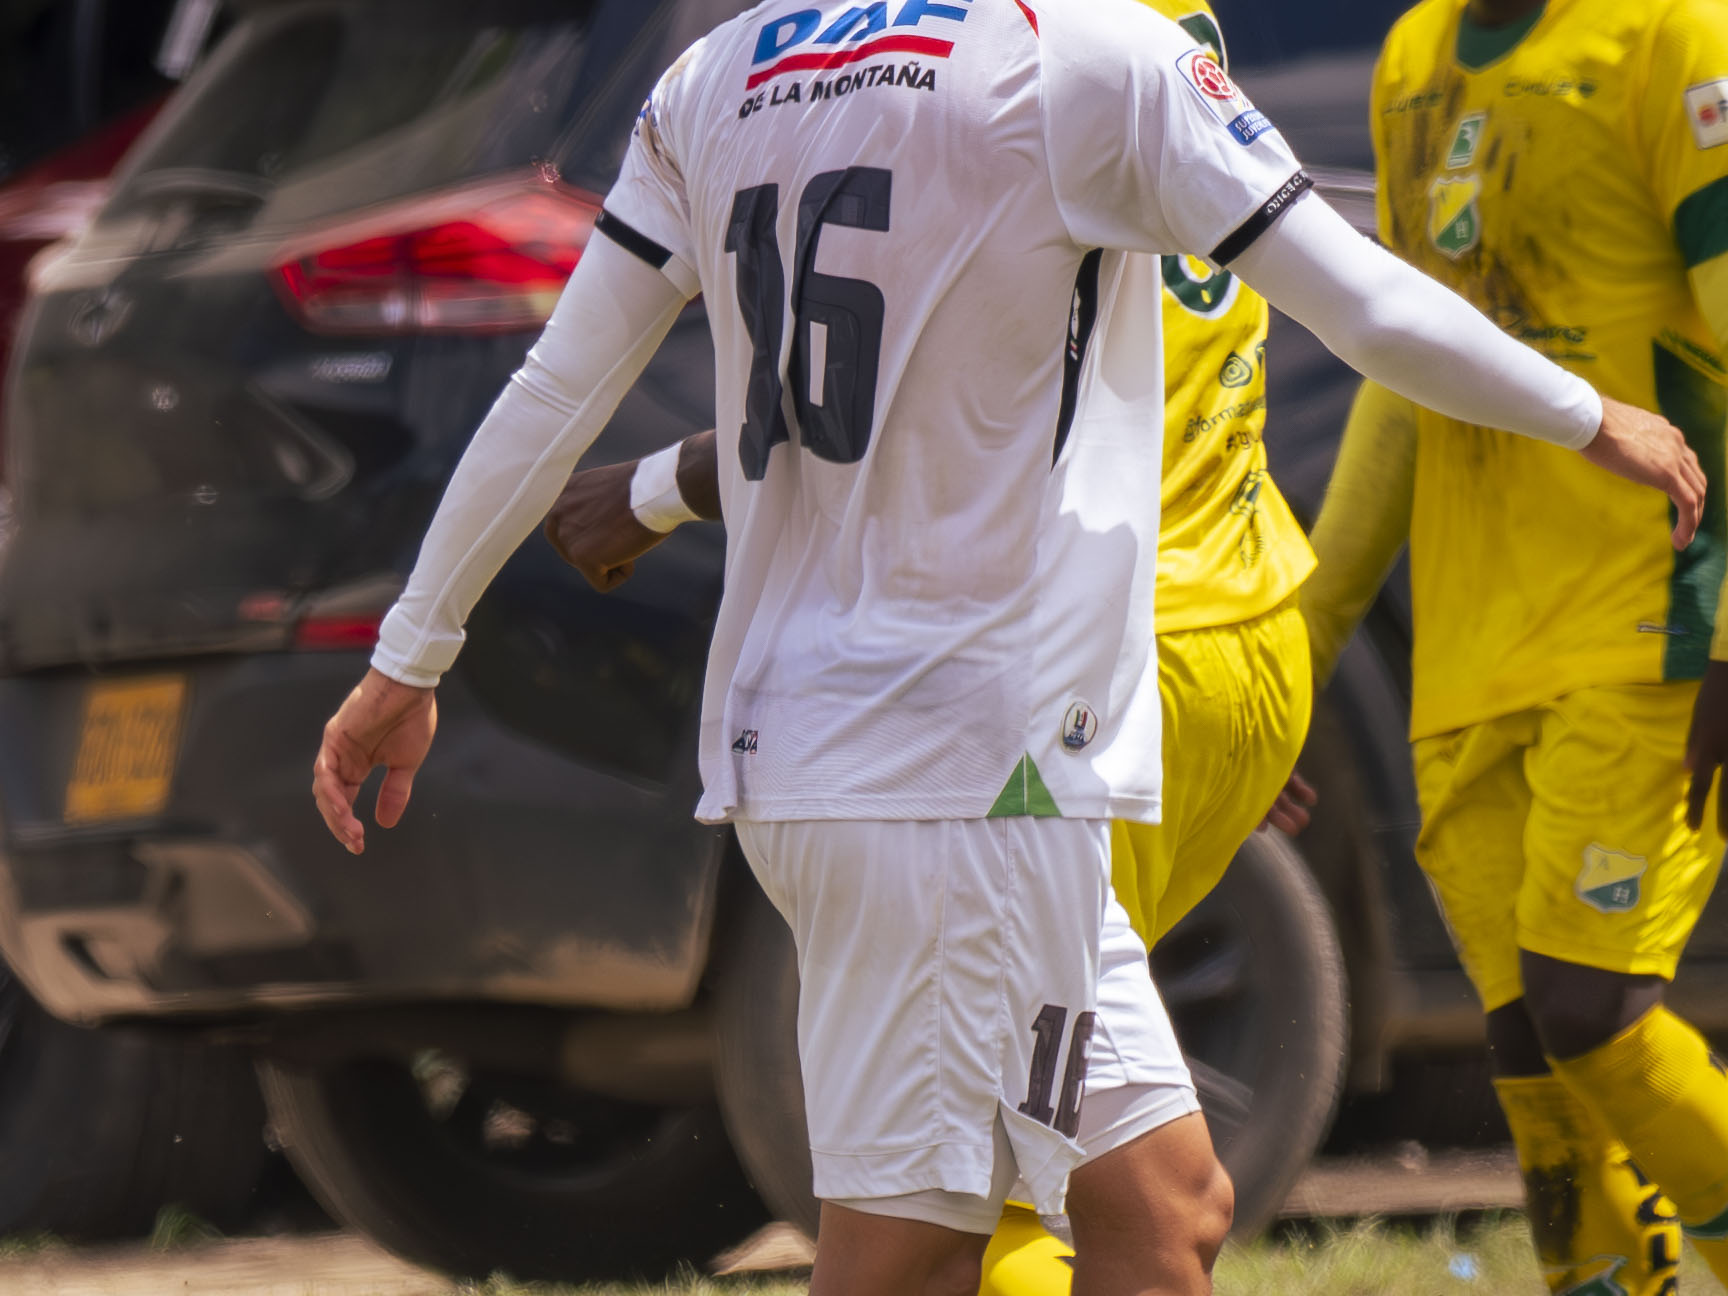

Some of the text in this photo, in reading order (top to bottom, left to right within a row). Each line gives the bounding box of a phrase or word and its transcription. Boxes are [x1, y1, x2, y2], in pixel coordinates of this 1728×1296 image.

[769, 82, 801, 105] LA
[810, 61, 936, 102] MONTAÑA
[724, 166, 892, 482] 16
